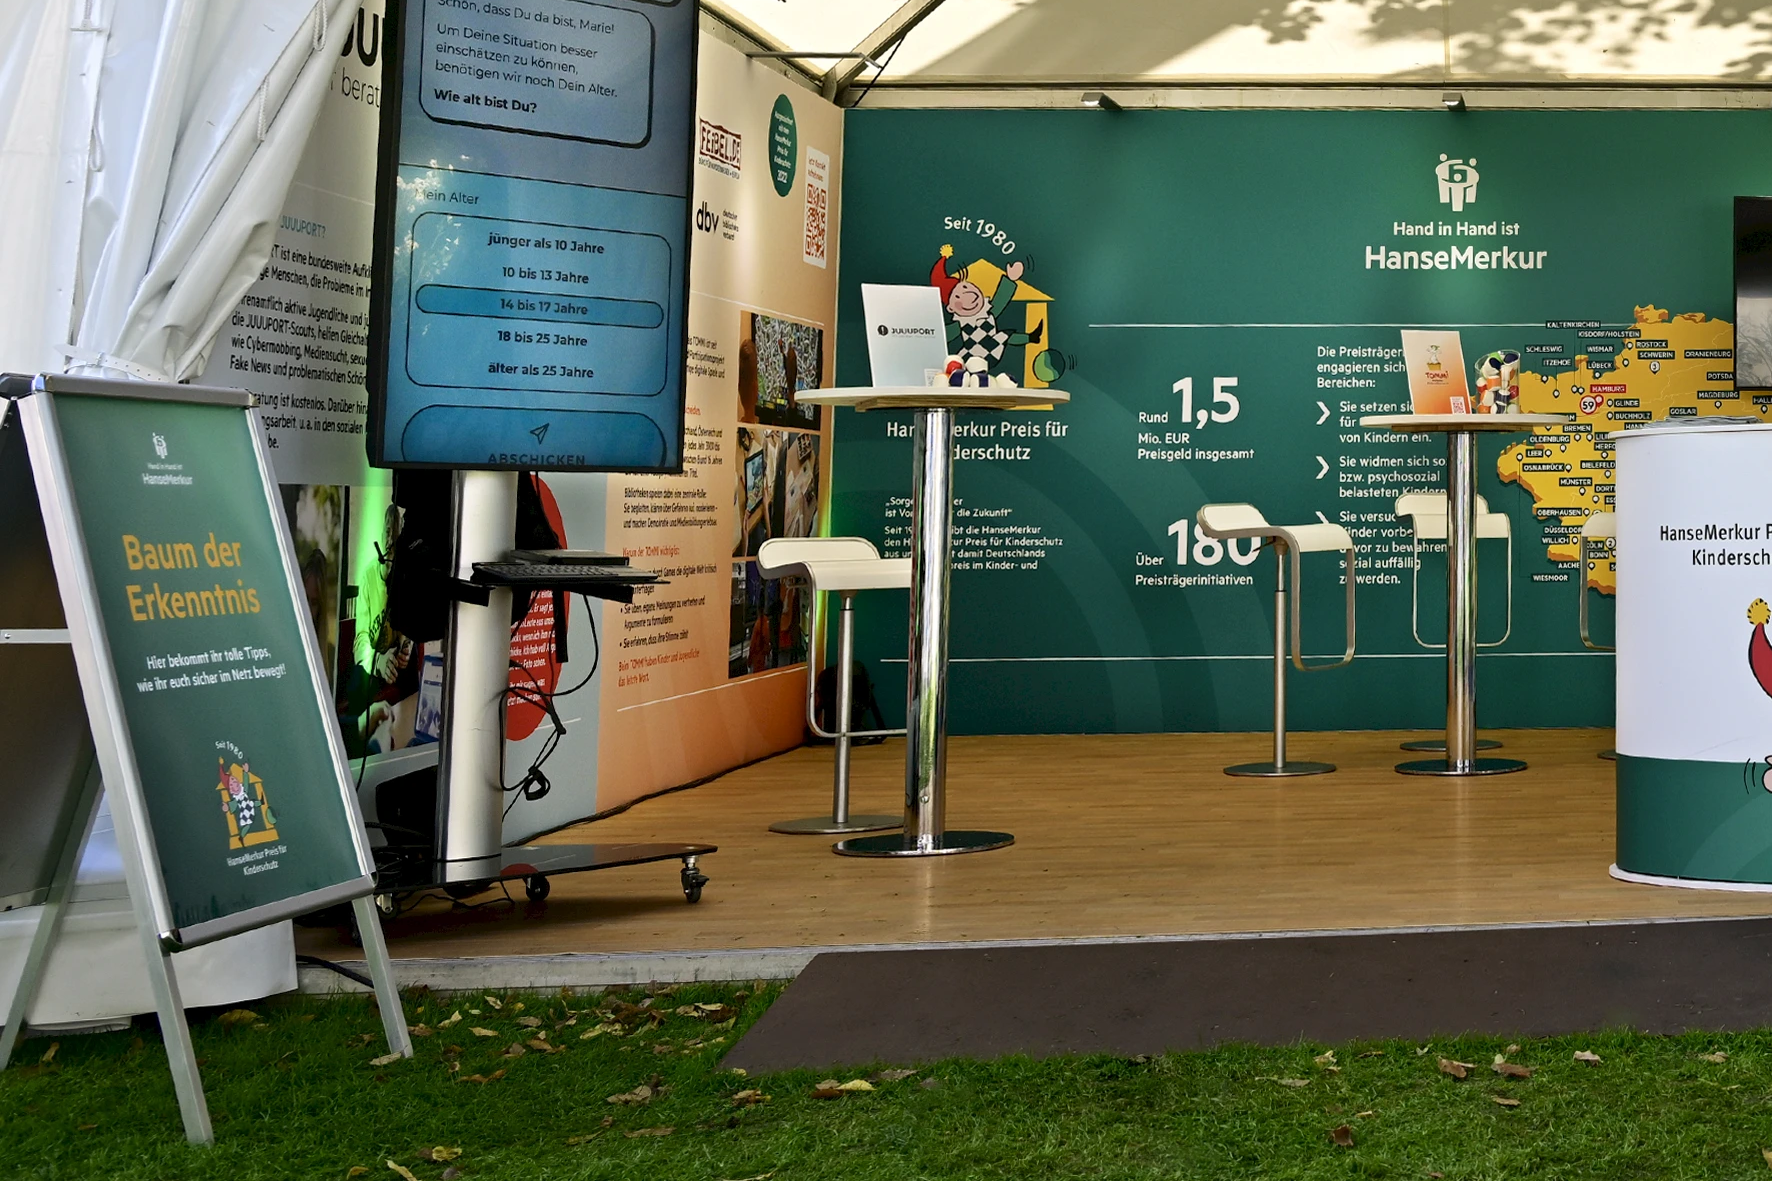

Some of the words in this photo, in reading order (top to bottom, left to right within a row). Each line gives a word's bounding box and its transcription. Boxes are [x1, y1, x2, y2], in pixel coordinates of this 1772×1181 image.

[483, 2, 511, 18] dass
[514, 7, 531, 19] Du
[535, 10, 549, 23] da
[553, 14, 577, 29] bist,
[580, 19, 614, 34] Marie!
[437, 23, 460, 35] Um
[463, 27, 500, 43] Deine
[503, 33, 557, 52] Situation
[561, 42, 598, 58] besser
[436, 42, 510, 63] einschätzen
[513, 55, 528, 66] zu
[531, 57, 578, 75] können,
[435, 60, 500, 80] benötigen
[503, 70, 521, 82] wir
[525, 73, 555, 89] noch
[559, 78, 585, 92] Dein
[588, 83, 617, 97] Alter.
[434, 89, 460, 102] Wie
[463, 93, 480, 106] alt
[484, 95, 508, 109] bist
[512, 99, 537, 113] Du?
[449, 192, 479, 205] Alter
[697, 201, 719, 234] dbv
[944, 217, 971, 231] Seit
[975, 218, 1016, 255] 1980
[1393, 222, 1435, 236] Hand
[1438, 222, 1452, 236] in
[1456, 222, 1497, 236] Hand
[1501, 222, 1520, 236] ist
[488, 232, 531, 248] jünger
[534, 236, 551, 249] als
[555, 240, 567, 250] 10
[570, 241, 604, 255] Jahre
[1366, 246, 1547, 270] HanseMerkur
[502, 267, 515, 278] 10
[519, 268, 536, 280] bis
[540, 270, 552, 281] 13
[556, 271, 589, 284] Jahre
[500, 299, 514, 310] 14
[518, 299, 536, 312] bis
[539, 301, 551, 312] 17
[554, 303, 588, 315] Jahre
[498, 331, 510, 342] 18
[515, 331, 533, 343] bis
[536, 333, 550, 345] 25
[553, 334, 587, 347] Jahre
[891, 328, 935, 336] JUUUPORT
[488, 363, 518, 375] älter
[522, 364, 539, 376] als
[542, 366, 557, 376] 25
[559, 366, 594, 379] Jahre
[1318, 377, 1376, 389] Bereichen:
[1139, 412, 1168, 423] Rund
[1172, 377, 1240, 429] 1,5
[1583, 401, 1594, 410] 59
[1139, 433, 1161, 444] Mio.
[1166, 433, 1190, 444] EUR
[488, 454, 585, 465] ABSCHICKEN
[1138, 448, 1192, 461] Preisgeld
[1196, 448, 1254, 461] insgesamt
[1660, 524, 1761, 541] HanseMerkur
[123, 533, 198, 571] Baum
[204, 532, 242, 569] der
[1136, 554, 1164, 566] Über
[1136, 574, 1253, 587] Preisträgerinitiativen
[125, 579, 261, 621] Erkenntnis
[147, 655, 166, 669] Hier
[167, 652, 209, 667] bekommt
[210, 650, 223, 662] ihr
[224, 648, 244, 661] tolle
[243, 646, 271, 660] Tipps,
[137, 678, 153, 692] wie
[154, 677, 167, 690] ihr
[170, 674, 191, 688] euch
[193, 672, 218, 685] sicher
[219, 670, 231, 682] im
[232, 667, 252, 680] Netz
[253, 663, 286, 679] bewegt!
